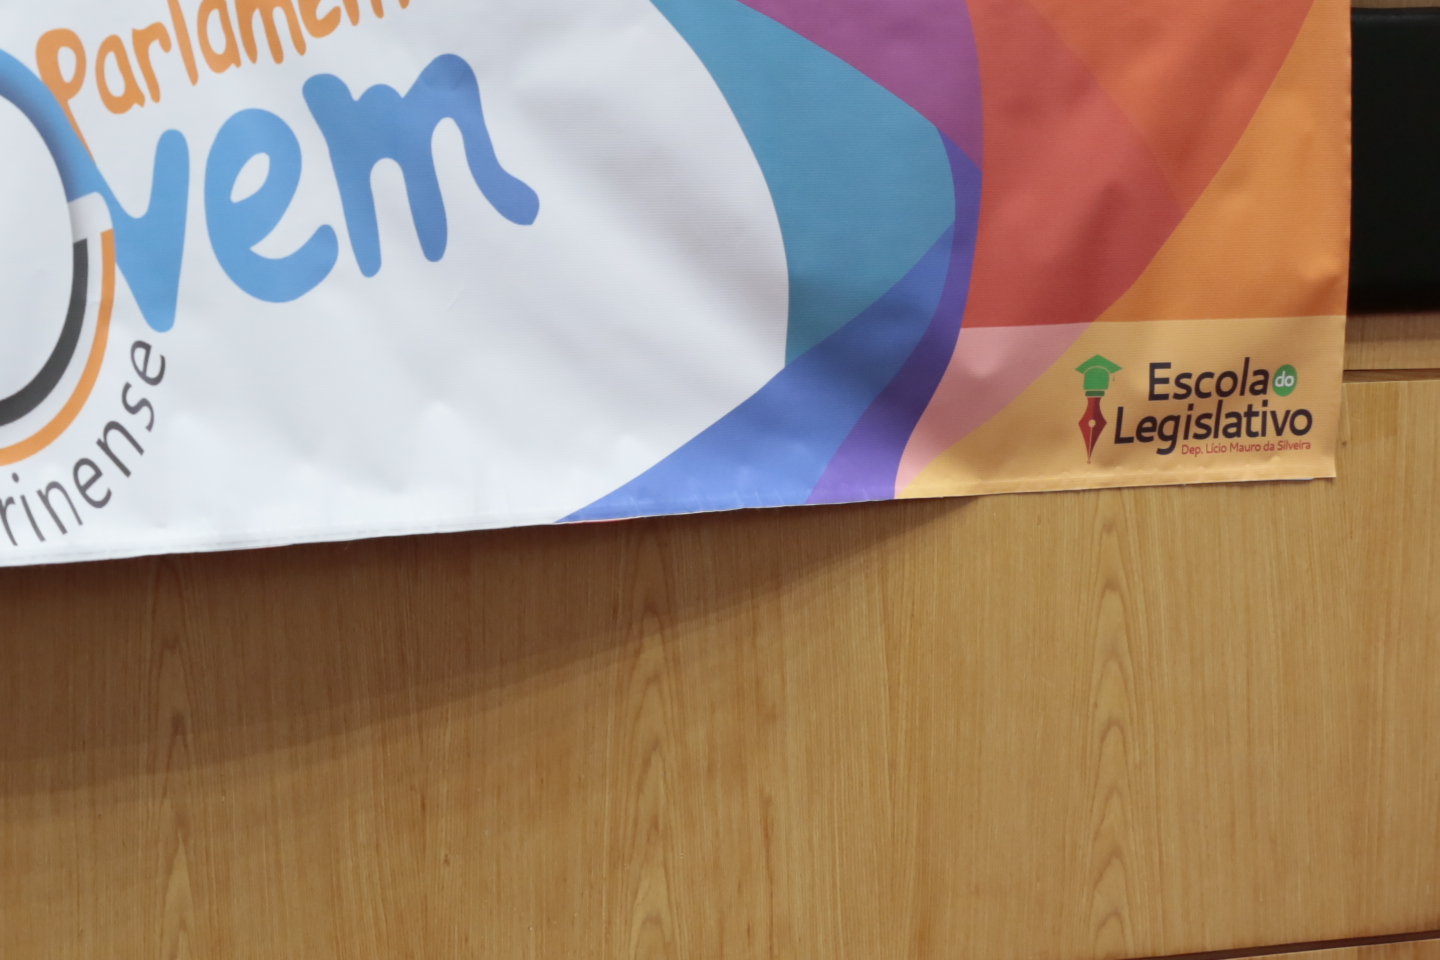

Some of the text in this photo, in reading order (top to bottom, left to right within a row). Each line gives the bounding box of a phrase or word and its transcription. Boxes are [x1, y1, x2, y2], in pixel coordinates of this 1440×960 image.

[1148, 357, 1295, 401] Escola do
[1114, 399, 1313, 455] Legislativo
[1181, 440, 1311, 457] Dep. Lício Mauro da Silveira
